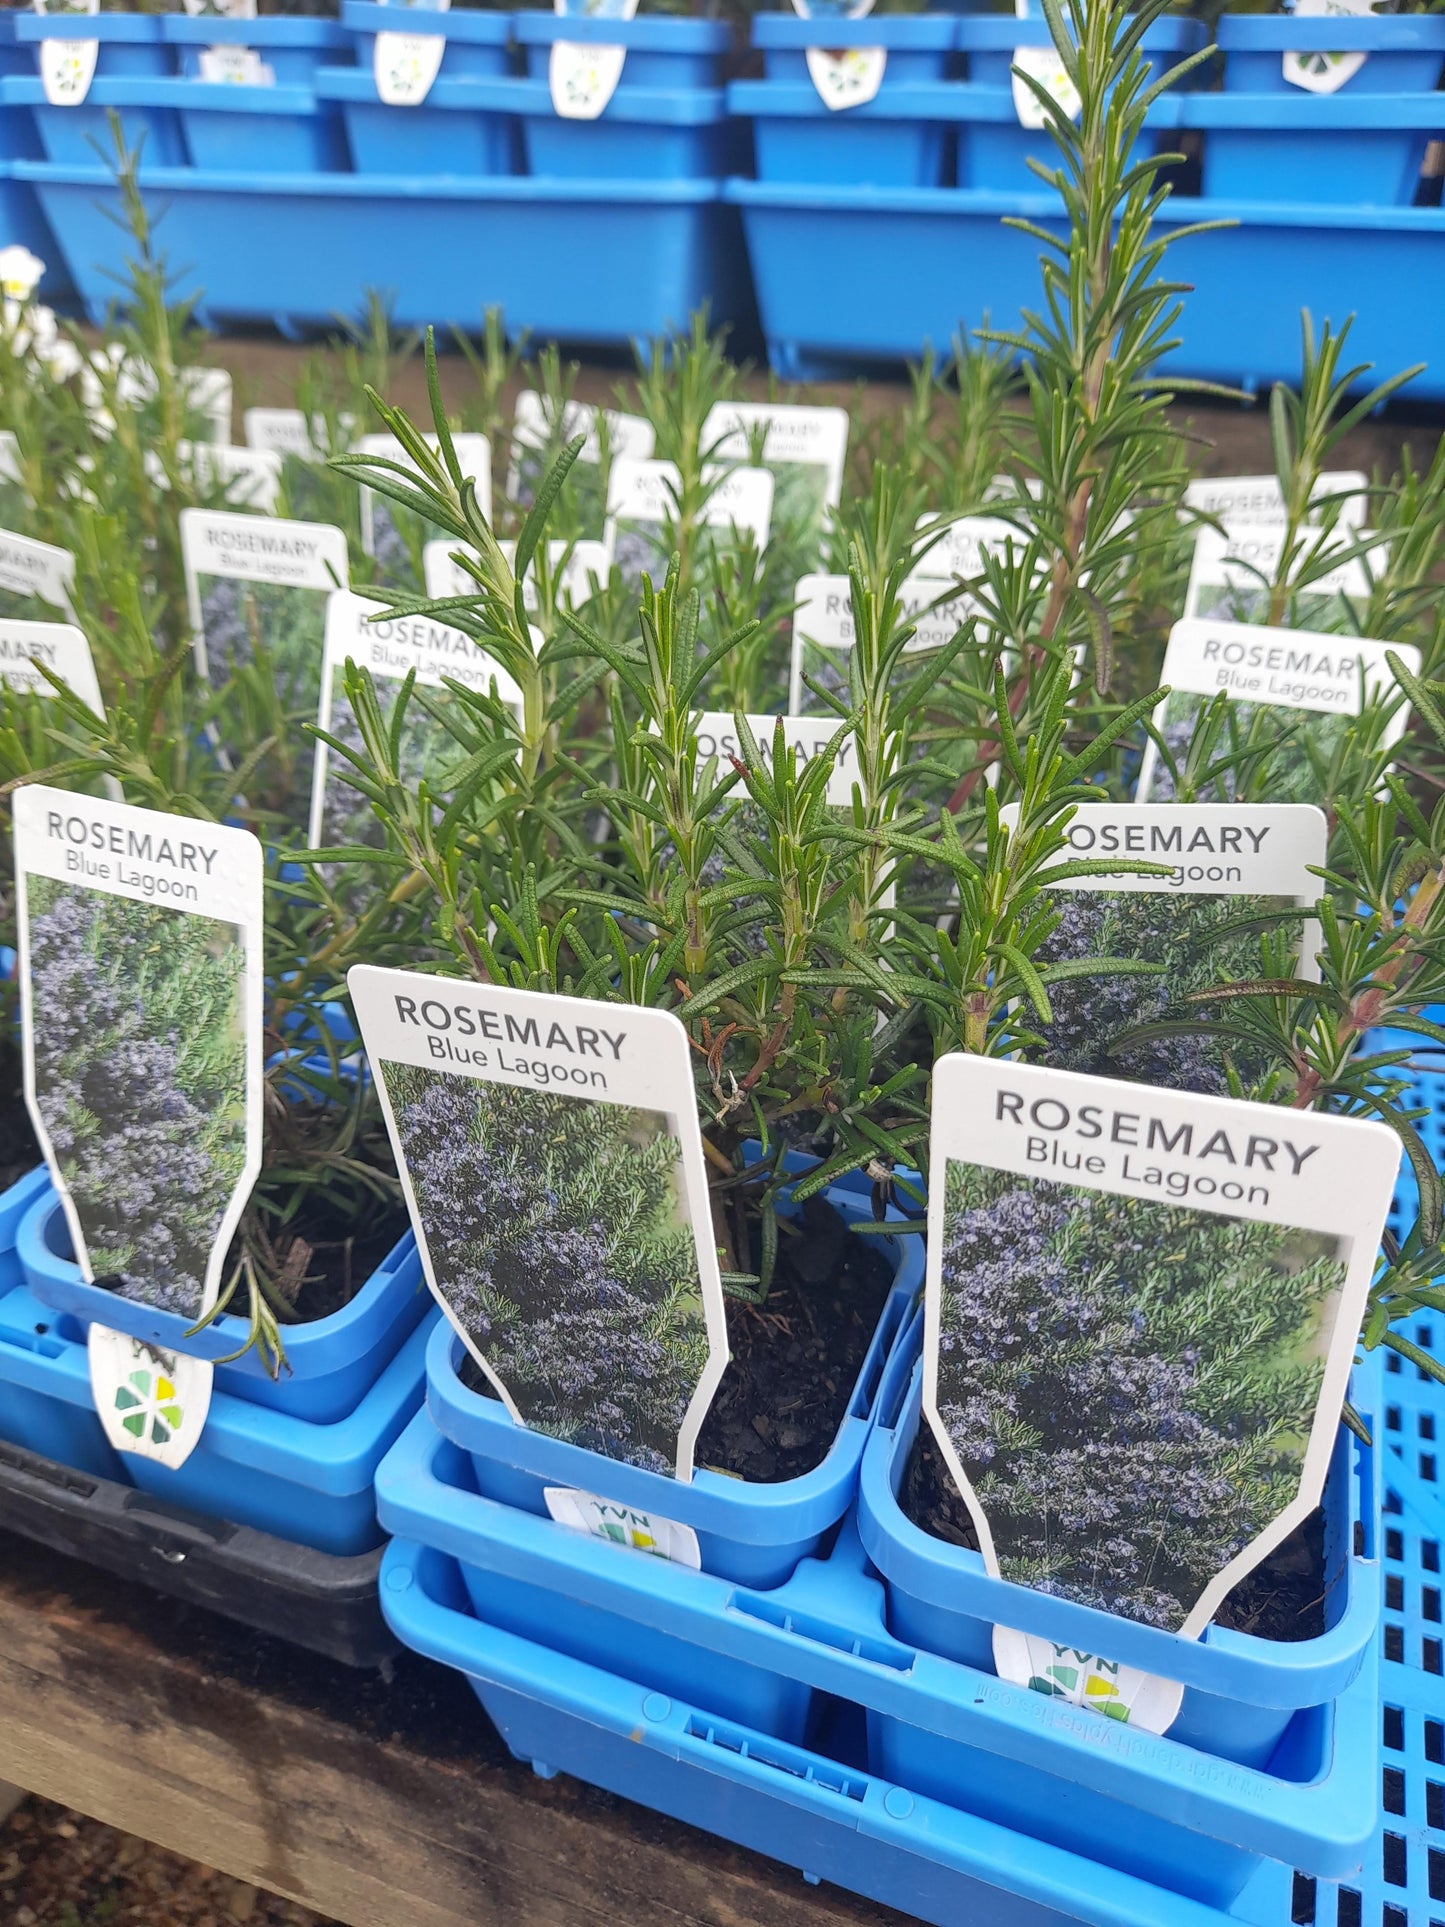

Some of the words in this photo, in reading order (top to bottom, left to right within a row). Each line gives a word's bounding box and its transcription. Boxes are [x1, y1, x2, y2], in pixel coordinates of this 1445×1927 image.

[357, 613, 486, 662] ROSEMA
[370, 645, 410, 669] Blue
[1215, 668, 1261, 691] Blue
[1268, 675, 1349, 702] Lagoon
[47, 810, 219, 875] ROSEMARY
[1063, 823, 1271, 854] OSEMARY
[66, 849, 111, 880] Blue
[118, 861, 199, 901] Lagoon
[394, 994, 627, 1061] ROSEMARY
[426, 1034, 488, 1067] Blue
[497, 1047, 608, 1089] Lagoon
[994, 1088, 1322, 1176] ROSEMARY
[1025, 1135, 1106, 1175] Blue
[1121, 1153, 1271, 1206] Lagoon
[591, 1501, 650, 1528] YVN
[1048, 1641, 1118, 1675] YVN
